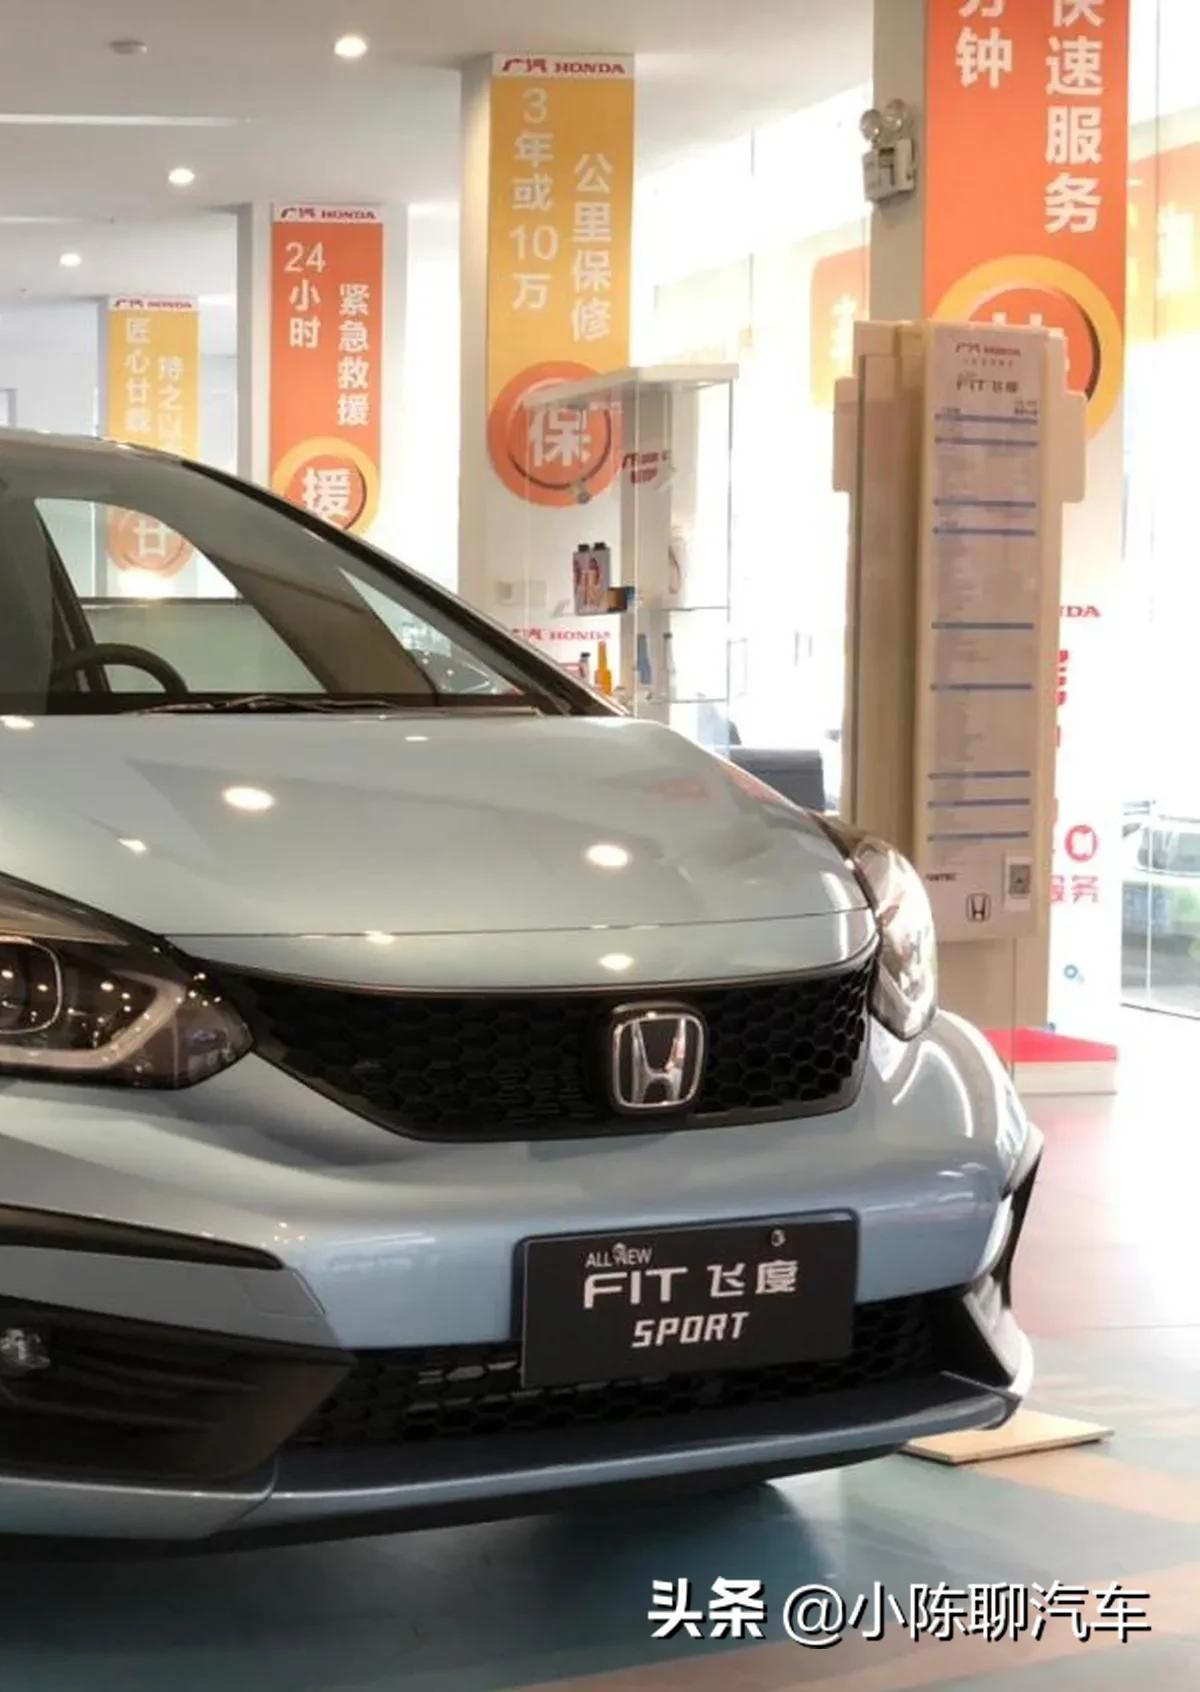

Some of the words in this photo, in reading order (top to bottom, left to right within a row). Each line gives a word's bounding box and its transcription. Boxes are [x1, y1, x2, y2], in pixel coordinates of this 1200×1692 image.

[554, 62, 626, 74] HONDA
[570, 152, 614, 343] 公里保修
[337, 282, 371, 426] 紧急救援
[1060, 604, 1101, 618] DA
[585, 1251, 613, 1269] ALL
[583, 1265, 689, 1310] FIT
[706, 1259, 800, 1299] 飞度
[631, 1310, 750, 1349] SPORT
